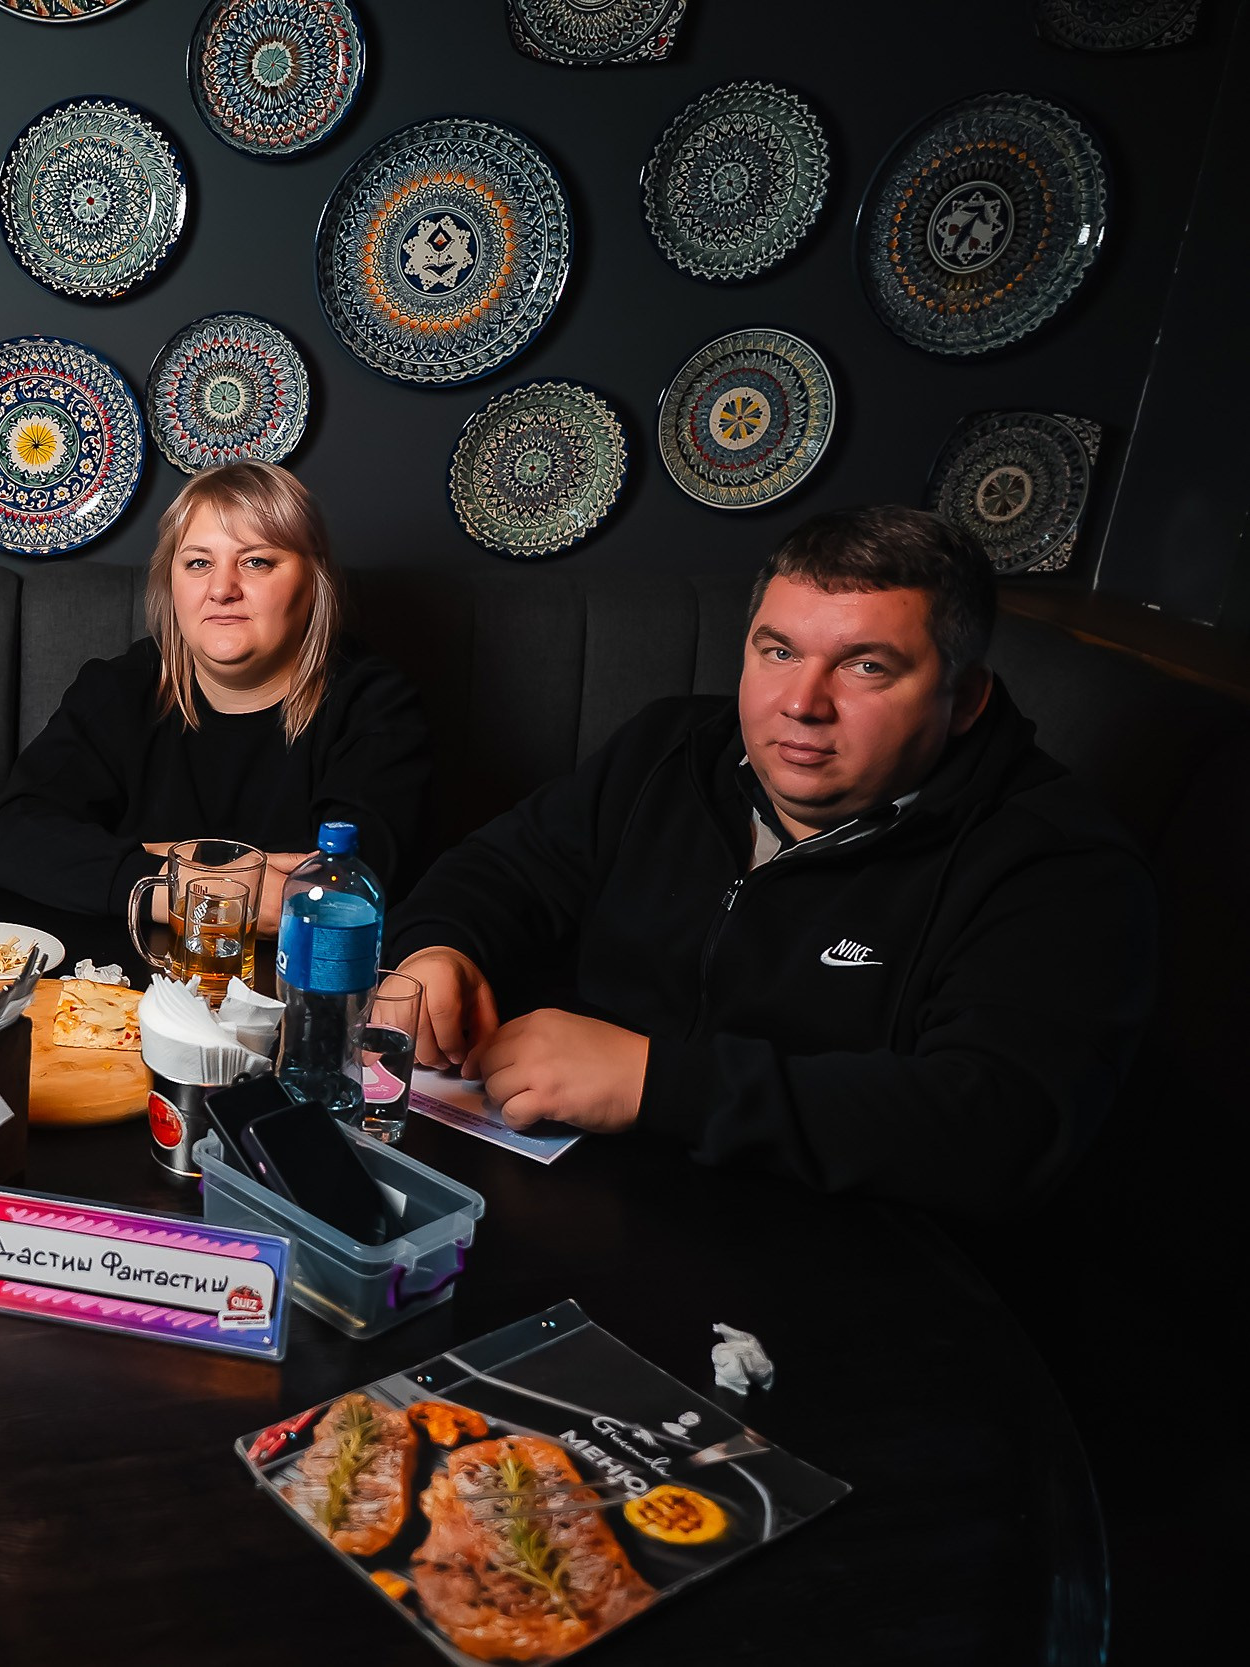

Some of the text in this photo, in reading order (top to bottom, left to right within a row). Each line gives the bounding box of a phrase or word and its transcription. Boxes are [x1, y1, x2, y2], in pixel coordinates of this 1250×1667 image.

[831, 938, 873, 962] NIKE
[101, 1250, 228, 1292] Фантастиш
[231, 1296, 258, 1310] QUIZ
[558, 1429, 649, 1495] МЕНЮ
